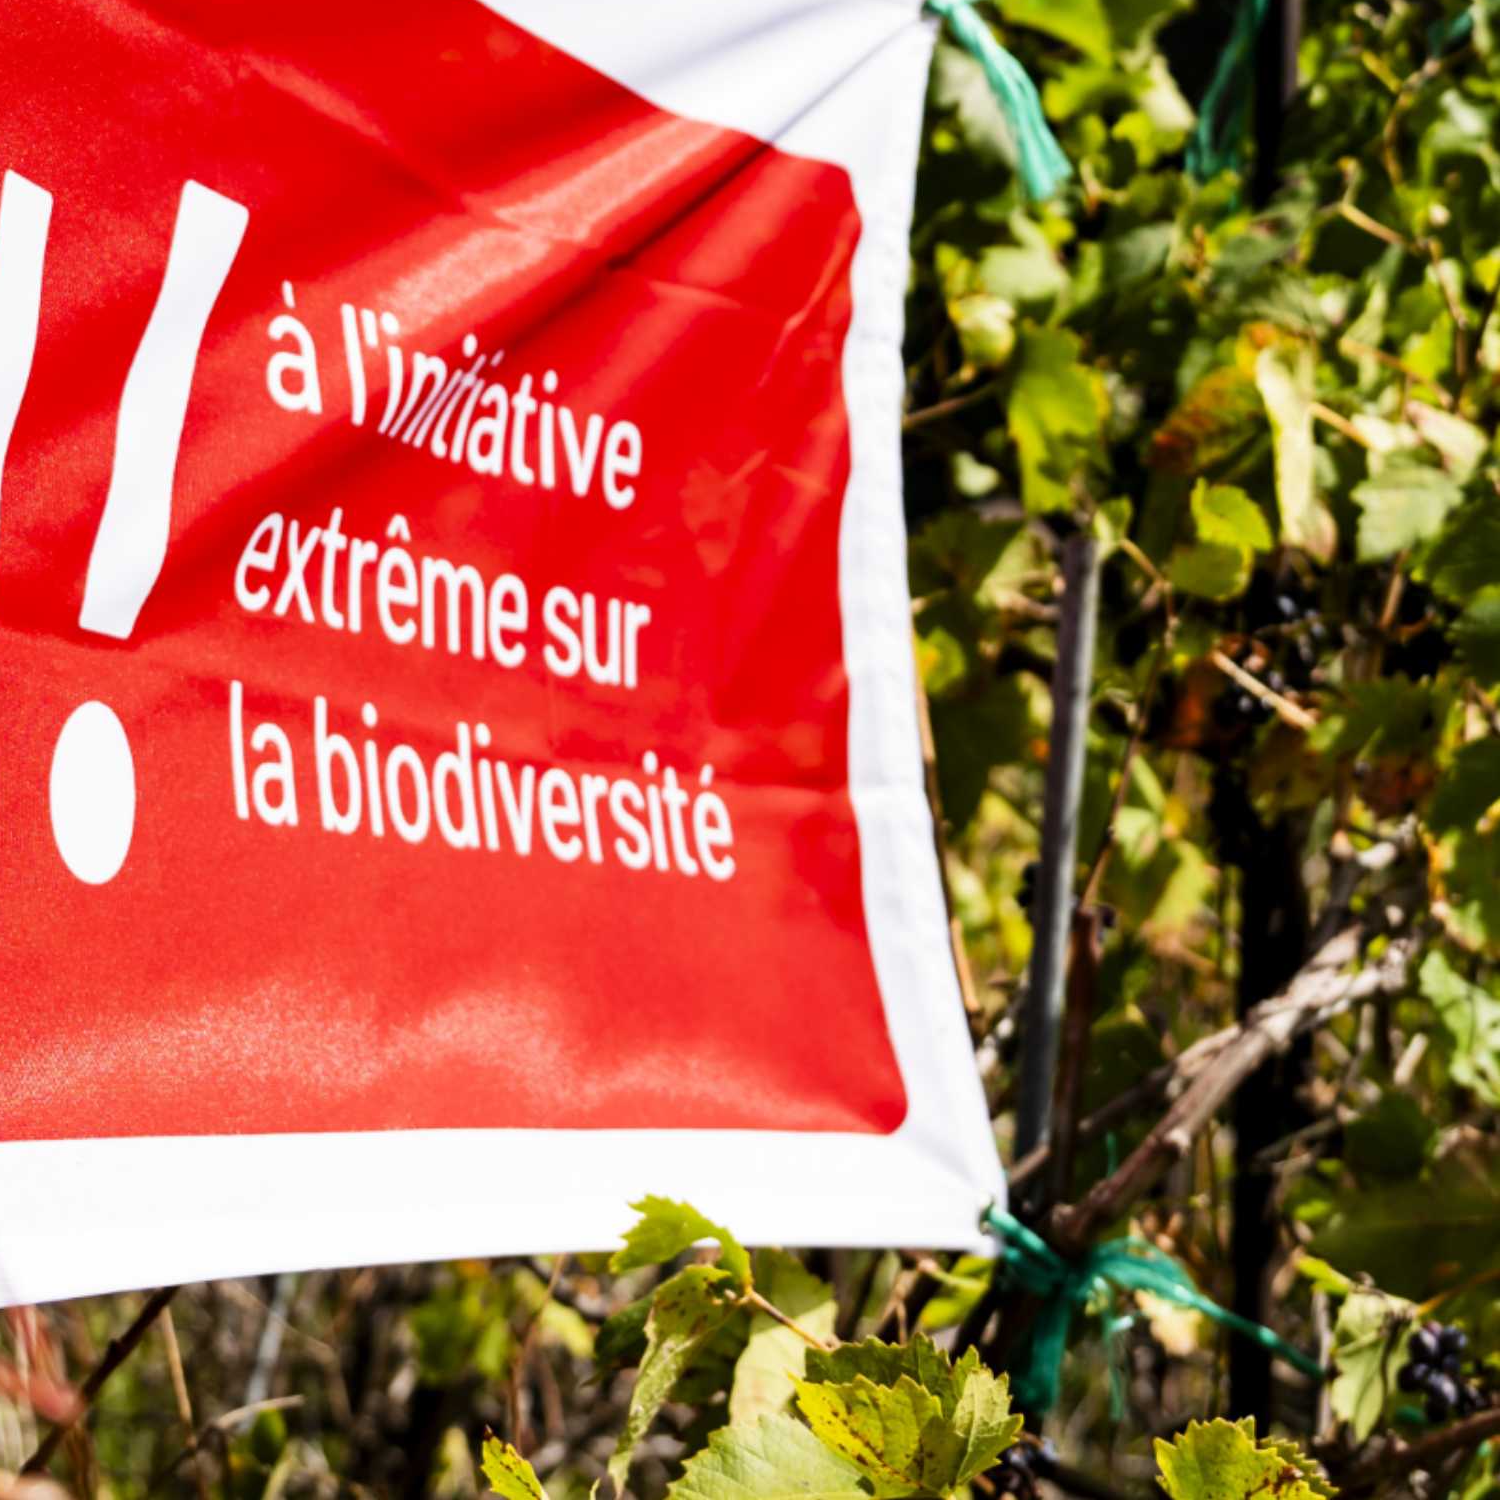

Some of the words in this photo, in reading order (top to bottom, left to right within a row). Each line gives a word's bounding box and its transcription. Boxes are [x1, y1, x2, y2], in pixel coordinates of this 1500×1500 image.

[266, 280, 323, 414] à
[342, 303, 642, 509] l'initiative
[234, 507, 528, 667] extrême
[543, 586, 651, 688] sur
[230, 679, 299, 827] la
[314, 695, 735, 880] biodiversité
